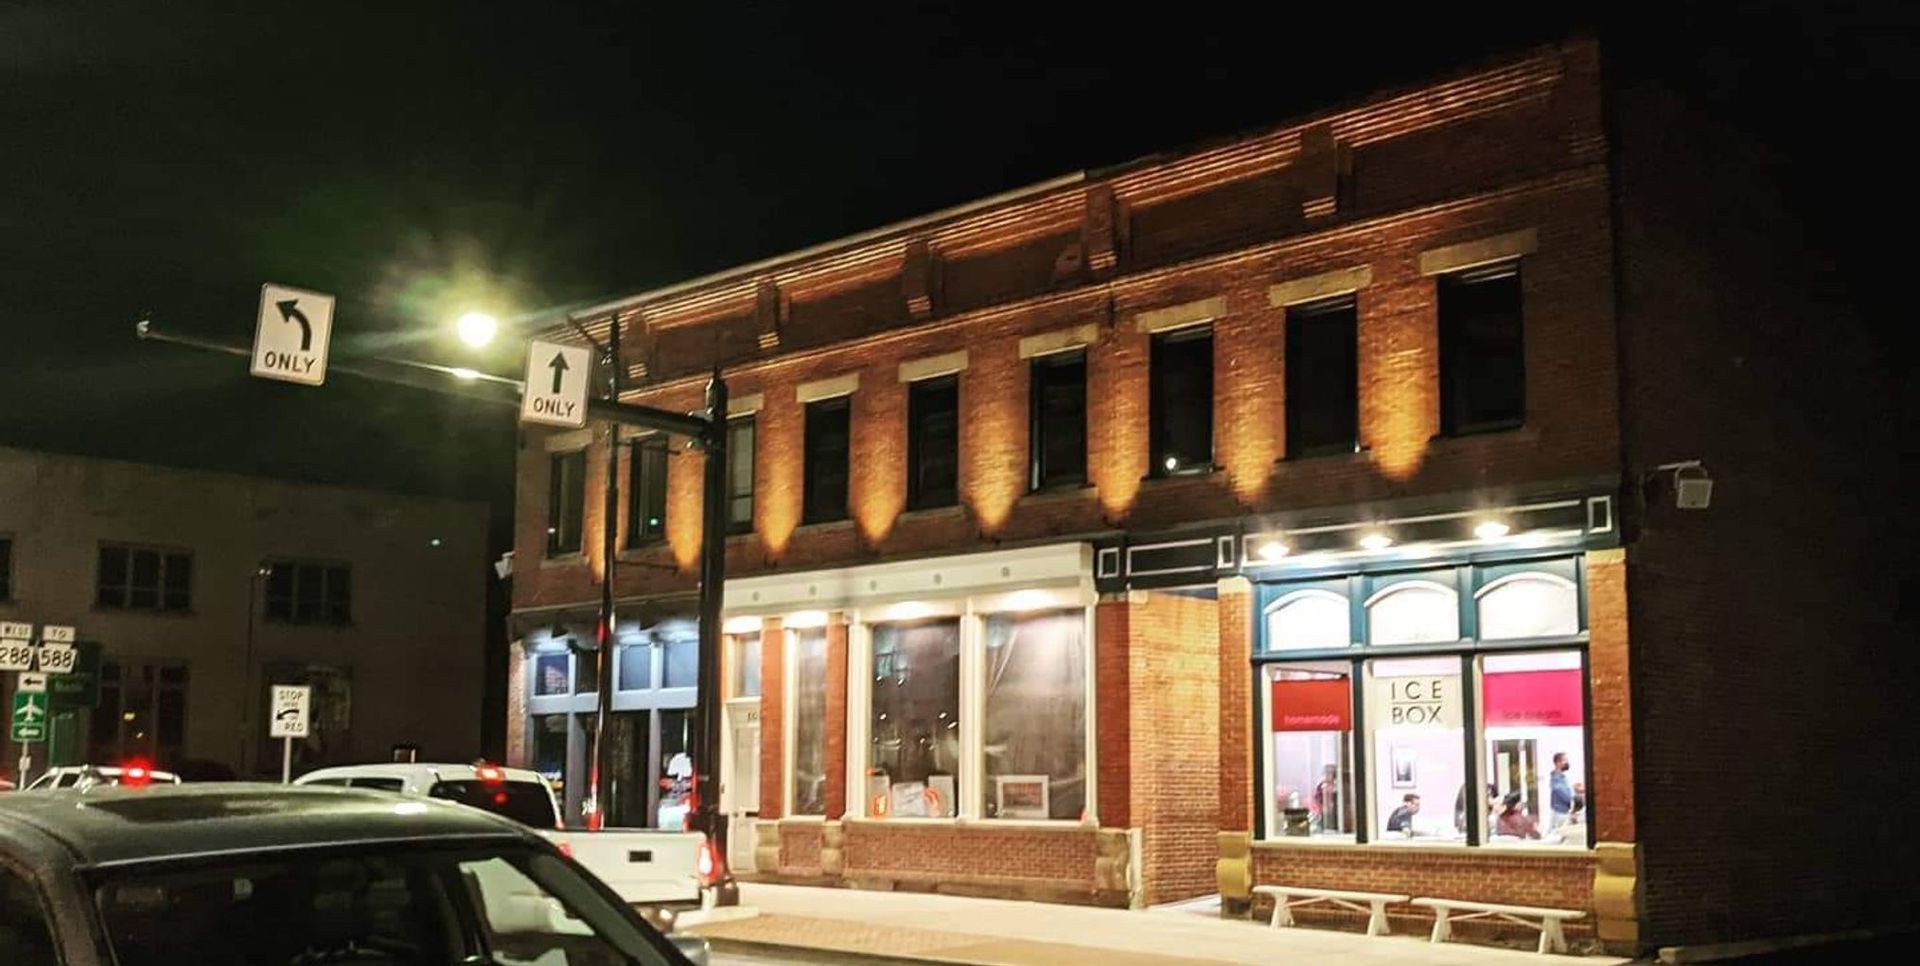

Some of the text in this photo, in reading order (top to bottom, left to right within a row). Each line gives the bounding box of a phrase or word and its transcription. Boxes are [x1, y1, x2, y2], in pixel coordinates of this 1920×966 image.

[265, 351, 316, 373] ONLY
[533, 397, 575, 417] ONLY
[51, 629, 67, 639] TO
[0, 647, 30, 665] 288
[40, 650, 72, 667] 588
[279, 690, 304, 701] STOP
[1391, 680, 1442, 700] ICE
[1284, 713, 1340, 725] homemade
[1392, 706, 1443, 725] BOX
[1503, 709, 1562, 720] ice cream
[284, 722, 304, 732] RED
